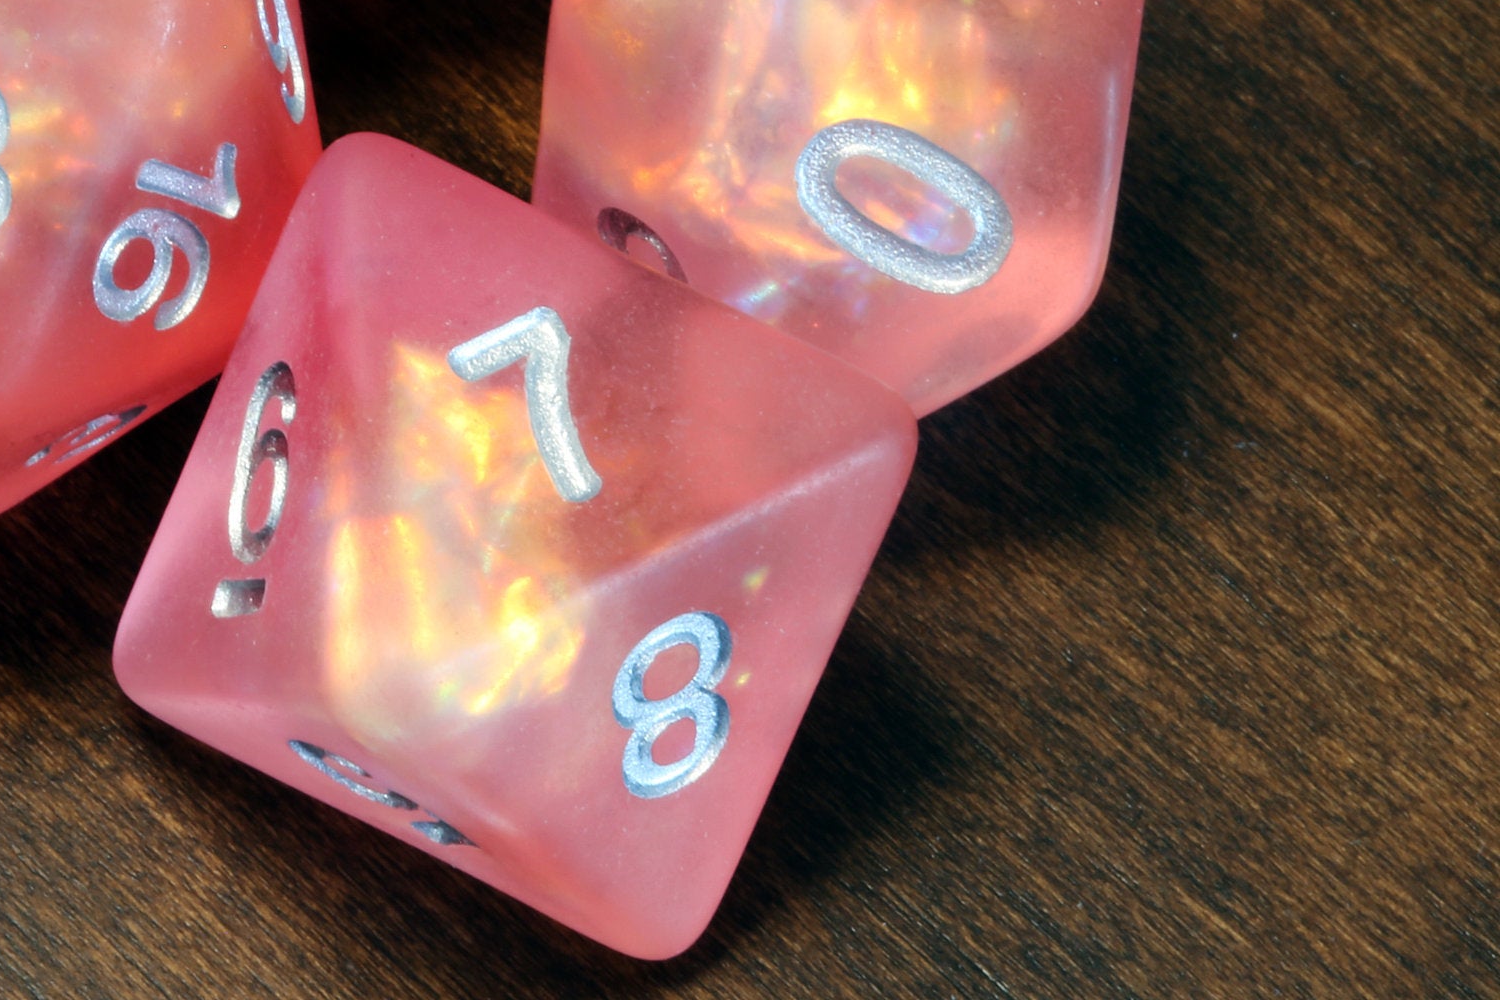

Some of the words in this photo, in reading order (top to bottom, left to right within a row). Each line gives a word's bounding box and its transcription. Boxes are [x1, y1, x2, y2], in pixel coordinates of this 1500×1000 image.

[796, 118, 1013, 295] 0
[447, 306, 603, 502] 7
[612, 611, 733, 799] 8
